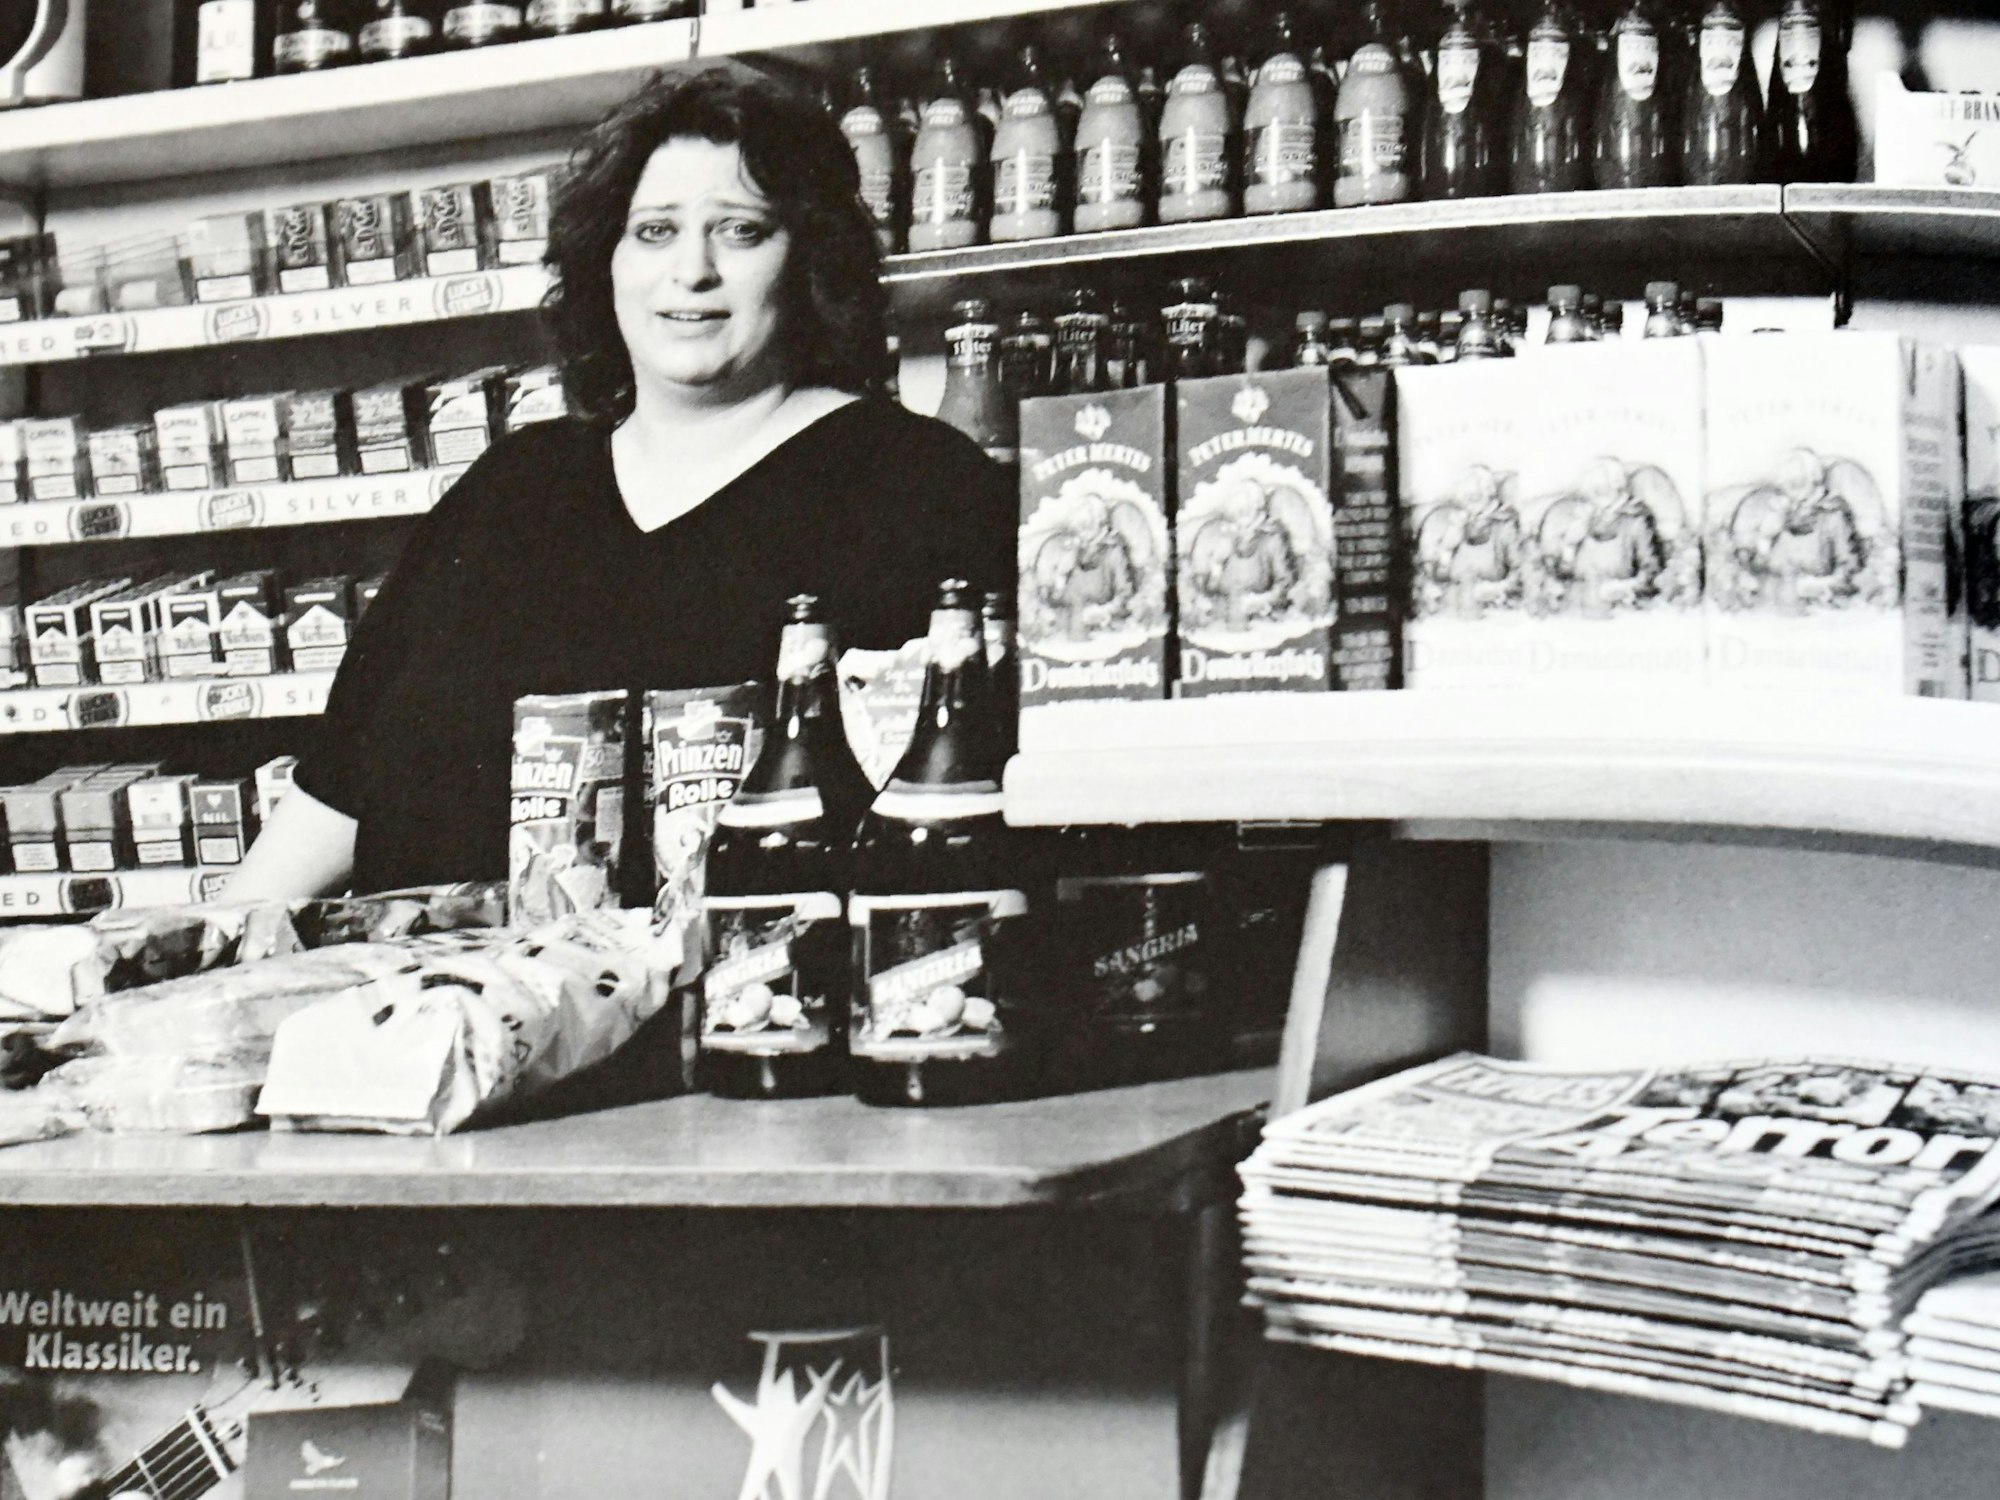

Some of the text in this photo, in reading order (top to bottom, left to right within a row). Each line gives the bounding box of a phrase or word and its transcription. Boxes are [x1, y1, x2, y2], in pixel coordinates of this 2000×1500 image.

[291, 297, 413, 325] SILVER
[287, 489, 408, 513] SILVER
[659, 740, 743, 778] Prinzen
[669, 779, 734, 811] Rolle
[1094, 923, 1198, 977] SANGRIA
[1590, 1105, 1996, 1170] Terror
[0, 1288, 227, 1328] Weltweit ein
[25, 1331, 200, 1373] Klassiker.
